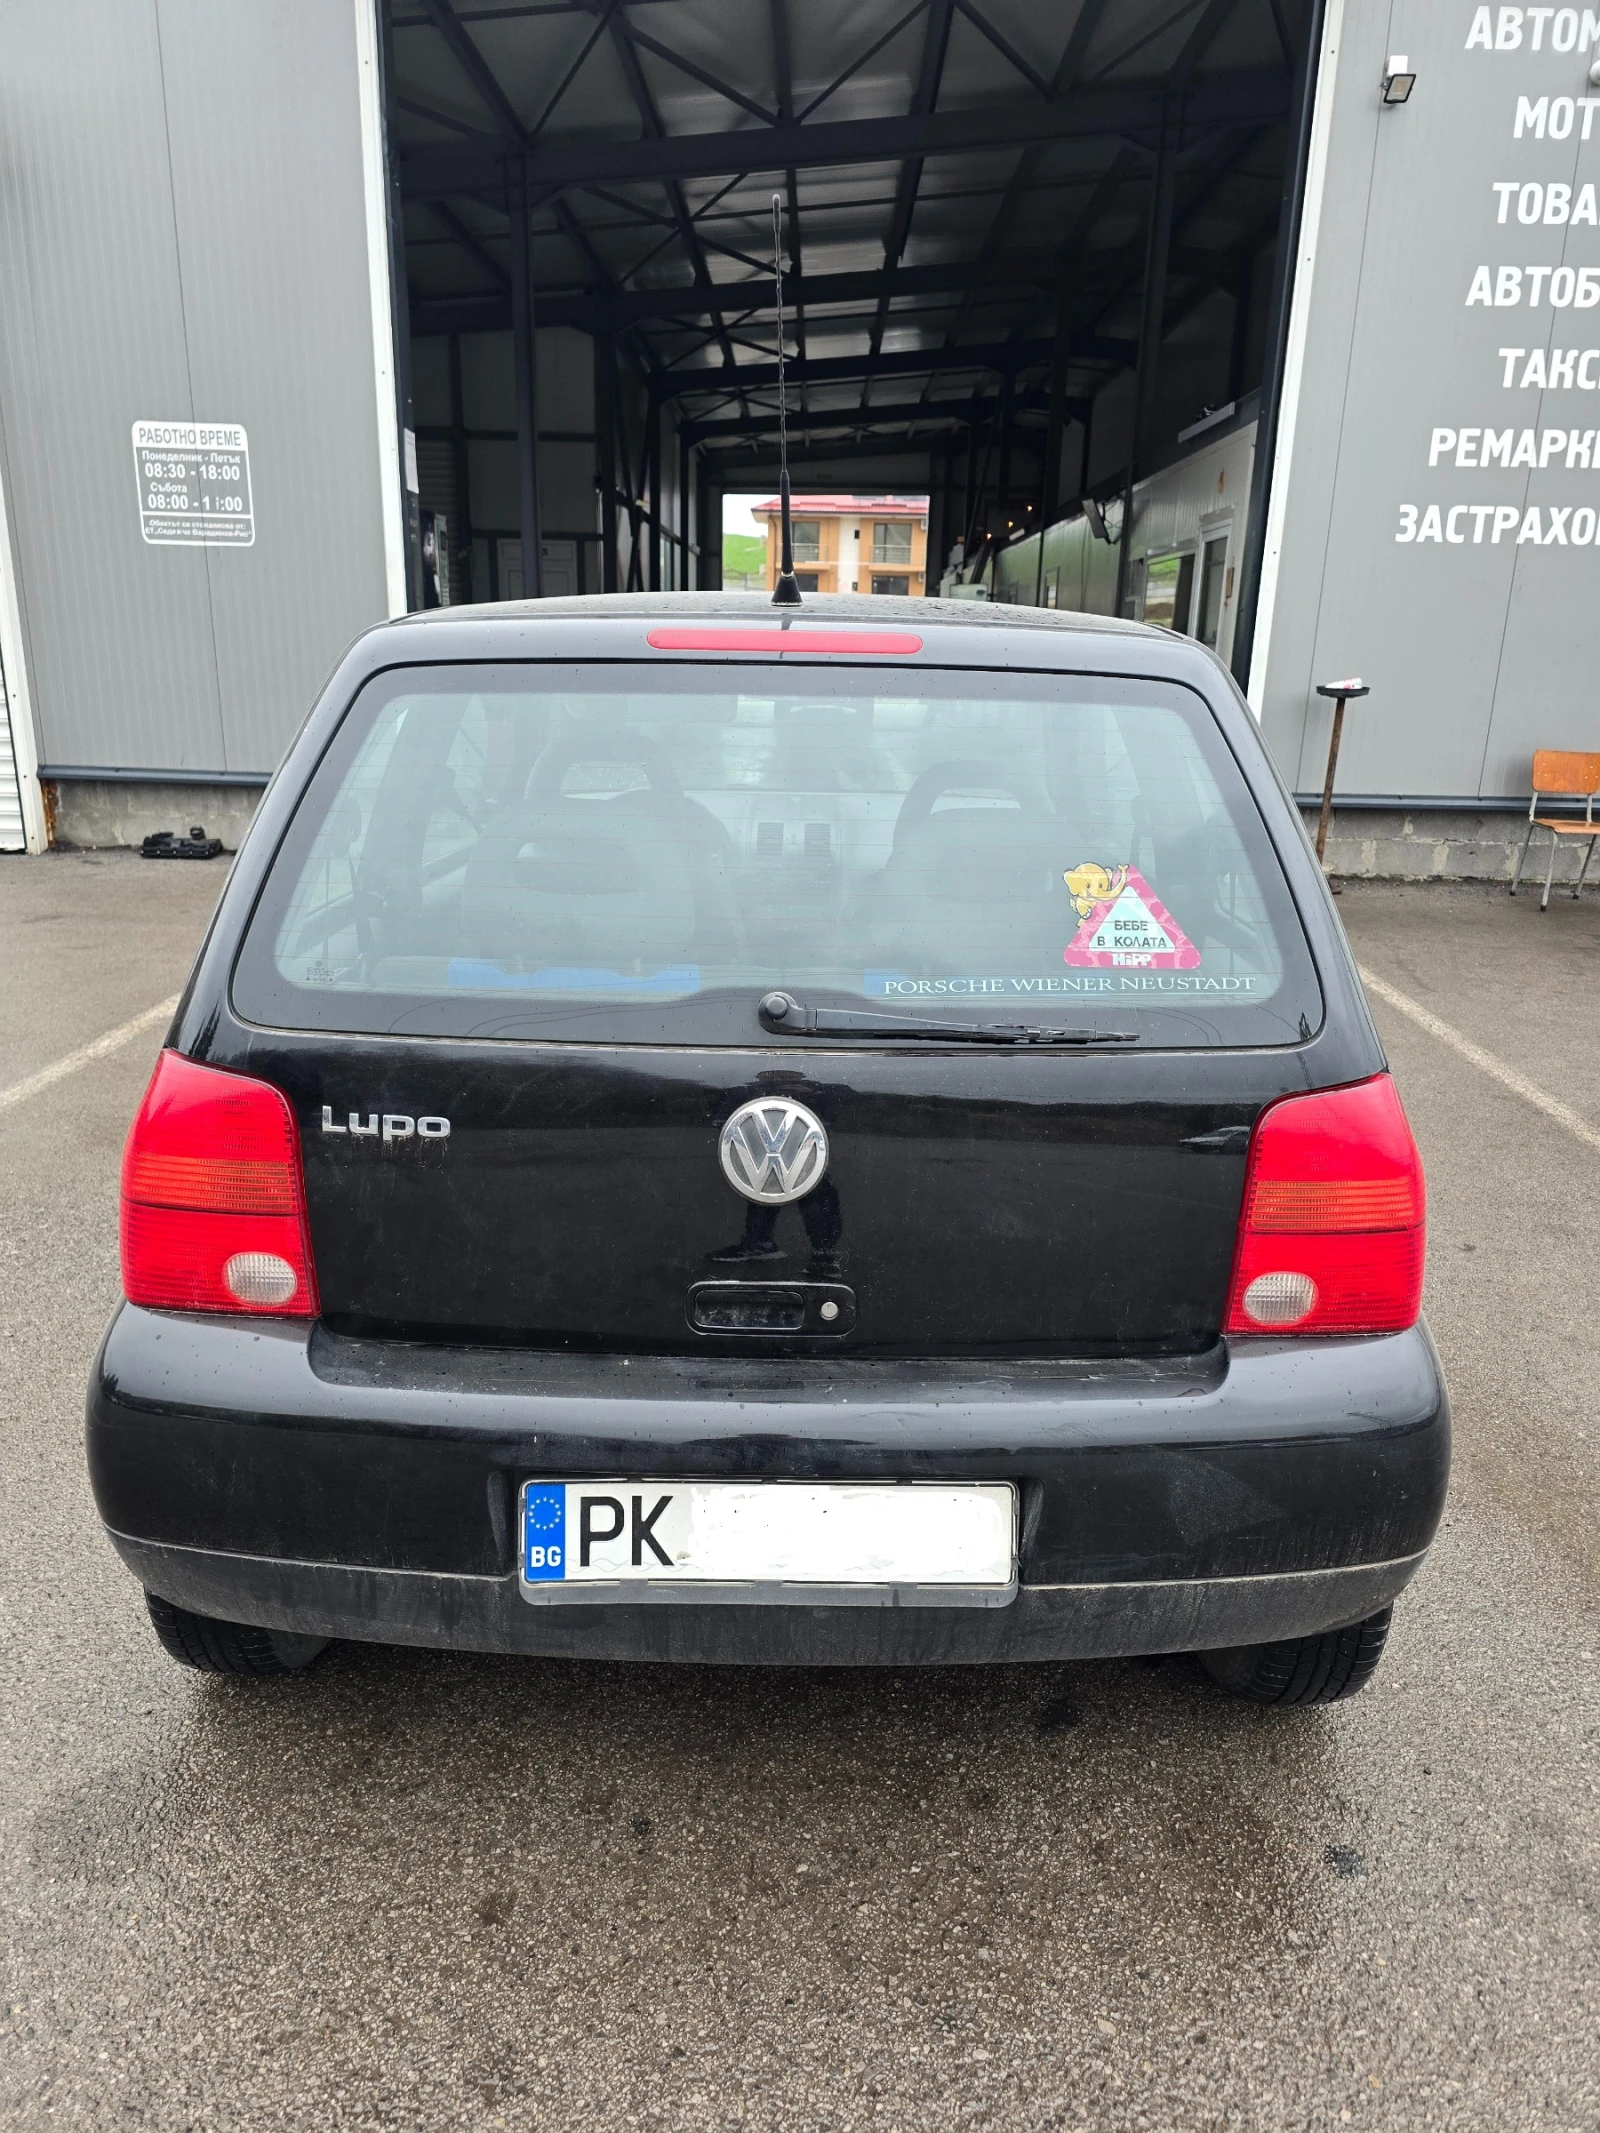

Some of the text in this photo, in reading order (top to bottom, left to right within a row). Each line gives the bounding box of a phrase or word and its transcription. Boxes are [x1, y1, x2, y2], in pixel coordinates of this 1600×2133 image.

[1513, 96, 1600, 140] МОТ
[1492, 182, 1600, 226] ТОВА
[1465, 265, 1600, 308] АВТОБ
[1498, 348, 1600, 390] ТАКС
[139, 428, 241, 446] РАБОТНО ВРЕМЕ
[142, 450, 202, 462] Понеделник
[210, 453, 241, 463] Петък
[145, 462, 186, 478] 08:30
[200, 464, 240, 480] 18:00
[150, 482, 187, 493] Събота
[148, 494, 188, 509] 08:00
[1395, 504, 1600, 545] ЗАСТРАХО
[1114, 920, 1148, 931] БЕБЕ
[1097, 936, 1167, 948] В КОЛАТА
[1112, 952, 1152, 966] HiPP
[884, 976, 1256, 995] PORSCHE WIENER NEUSTADT
[322, 1105, 451, 1141] Lupo
[531, 1495, 675, 1567] BG PK
